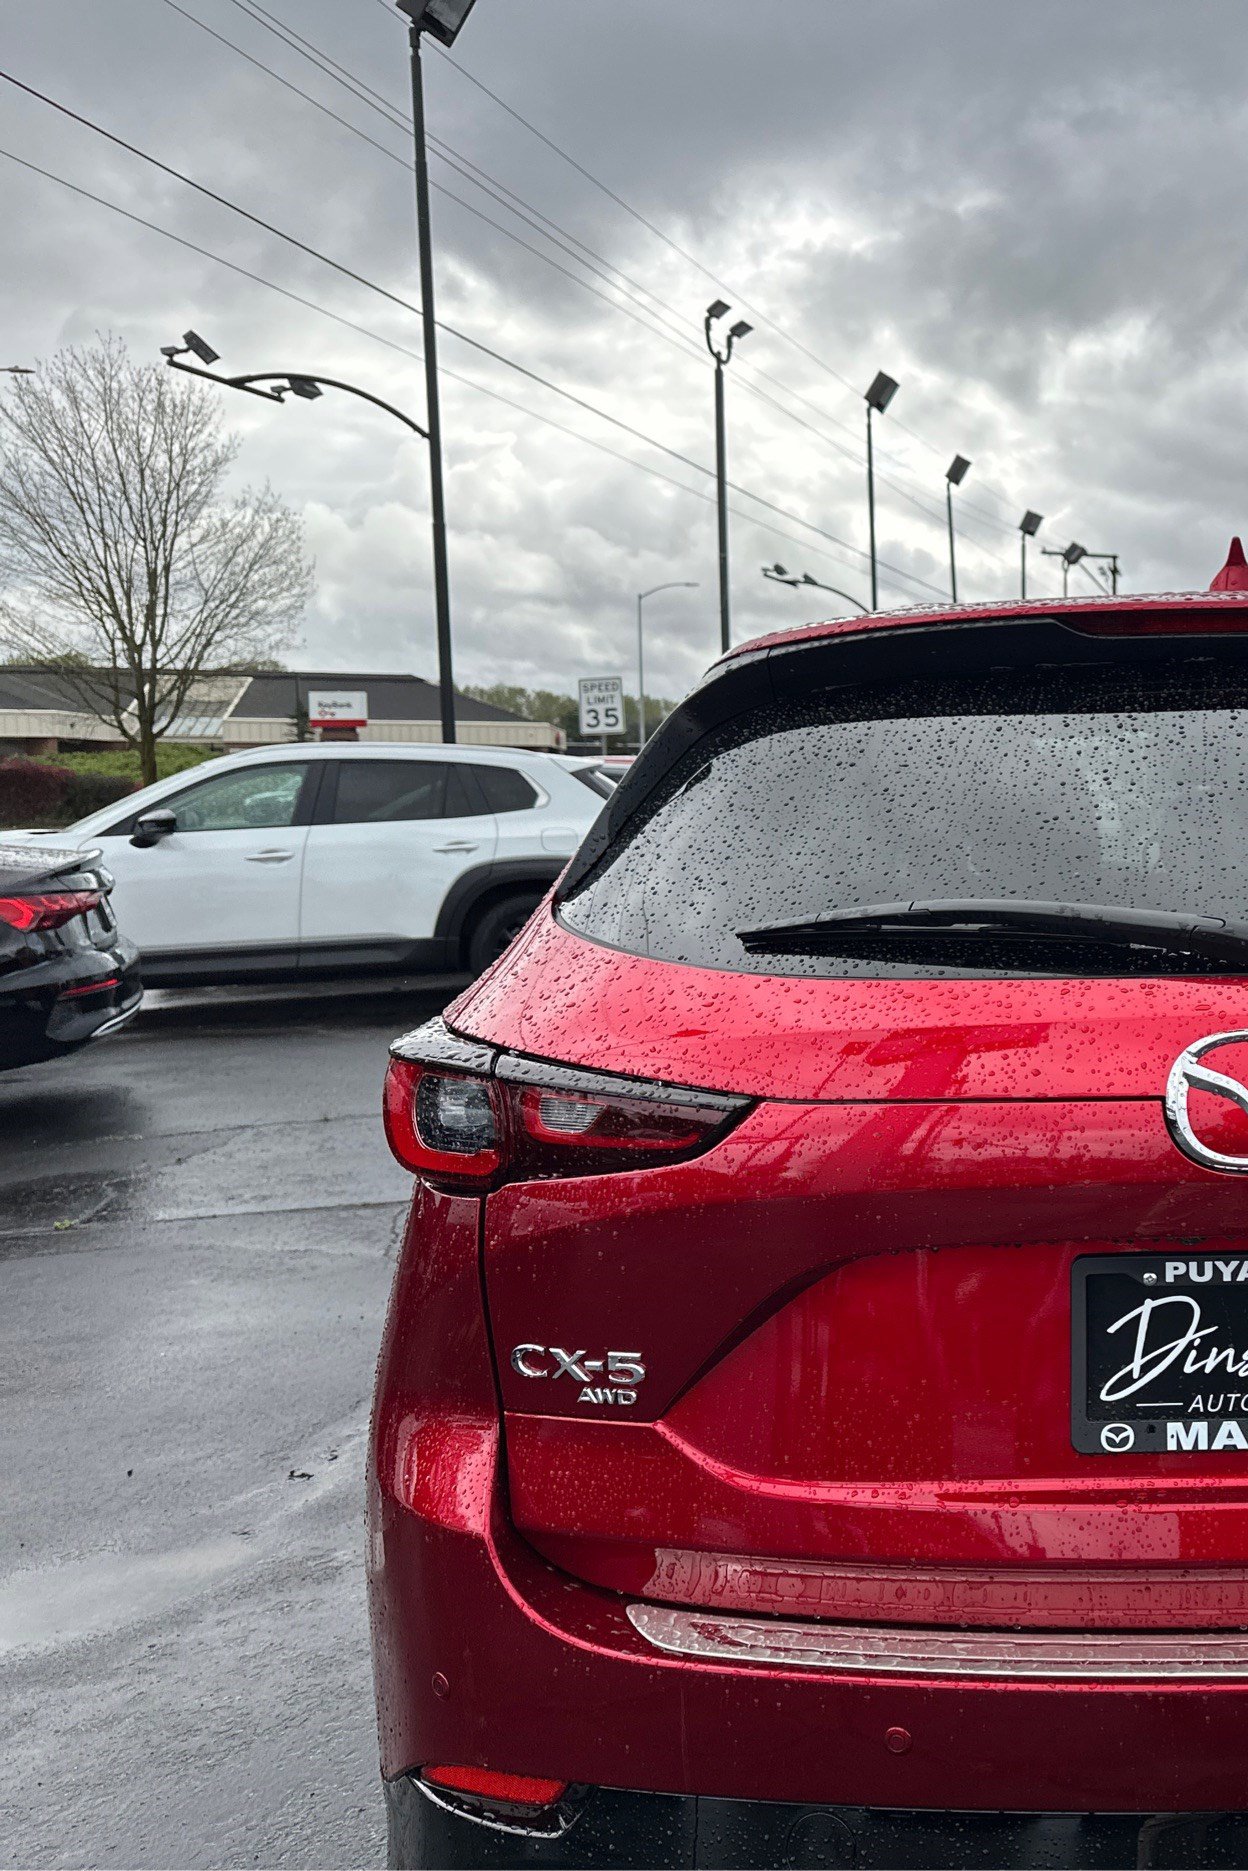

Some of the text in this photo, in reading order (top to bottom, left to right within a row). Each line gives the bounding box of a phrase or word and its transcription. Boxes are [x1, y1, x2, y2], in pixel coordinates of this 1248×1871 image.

[582, 681, 619, 693] SPEED
[586, 695, 614, 706] LIMIT
[586, 708, 619, 728] 35
[511, 1343, 647, 1385] CX-5
[577, 1386, 637, 1405] AWD
